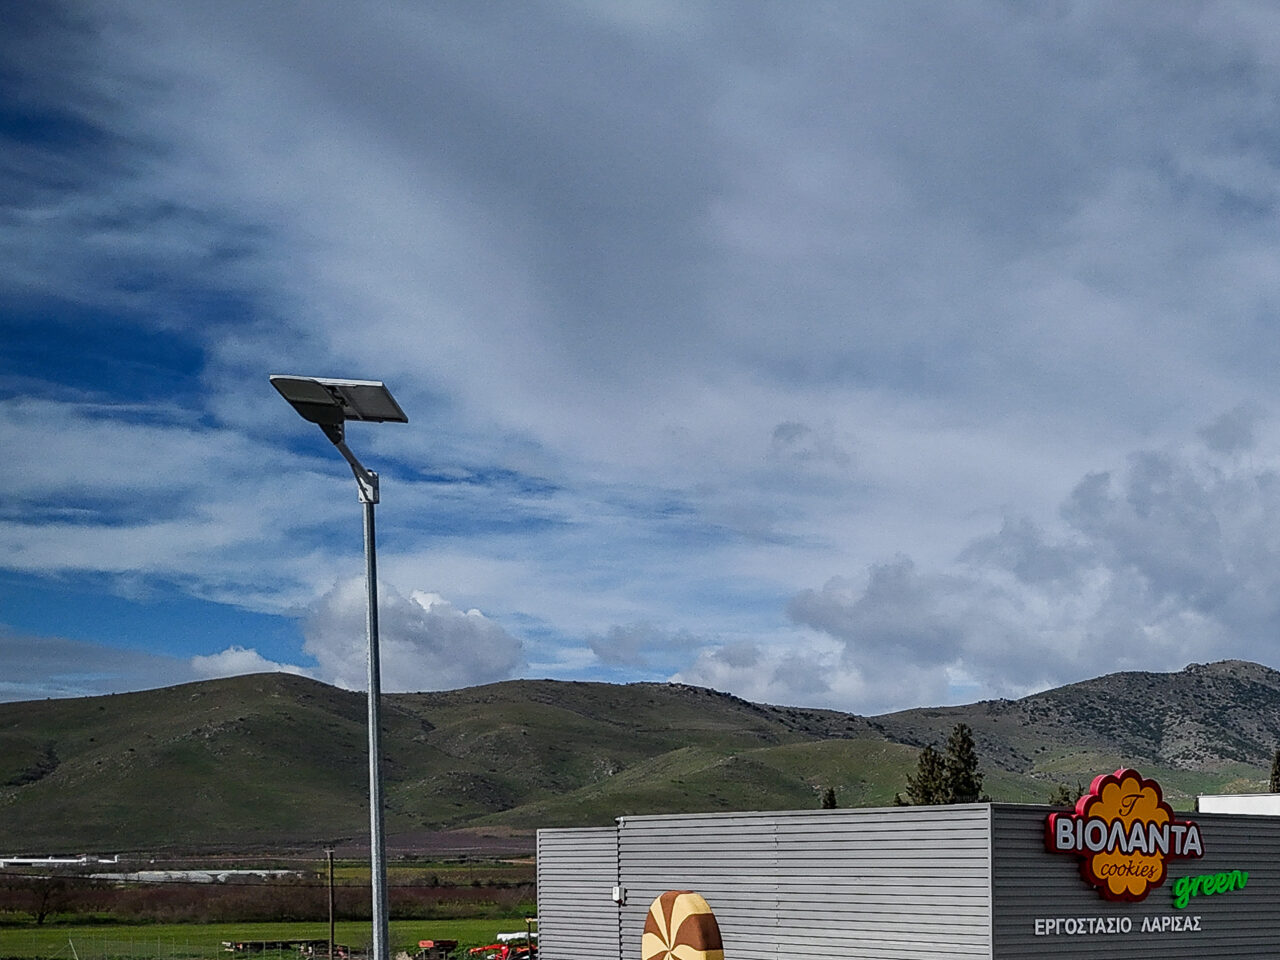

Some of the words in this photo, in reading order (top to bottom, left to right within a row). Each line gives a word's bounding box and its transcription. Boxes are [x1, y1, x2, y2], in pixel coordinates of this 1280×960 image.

[1056, 818, 1202, 856] ΒΙΟΛΑΝΤΑ
[1100, 860, 1158, 878] cookies
[1172, 869, 1249, 909] green
[1034, 917, 1132, 935] ΕΡΓΟΣΤΑΣΙΟ
[1141, 916, 1202, 932] ΛΑΡΙΣΑΣ
